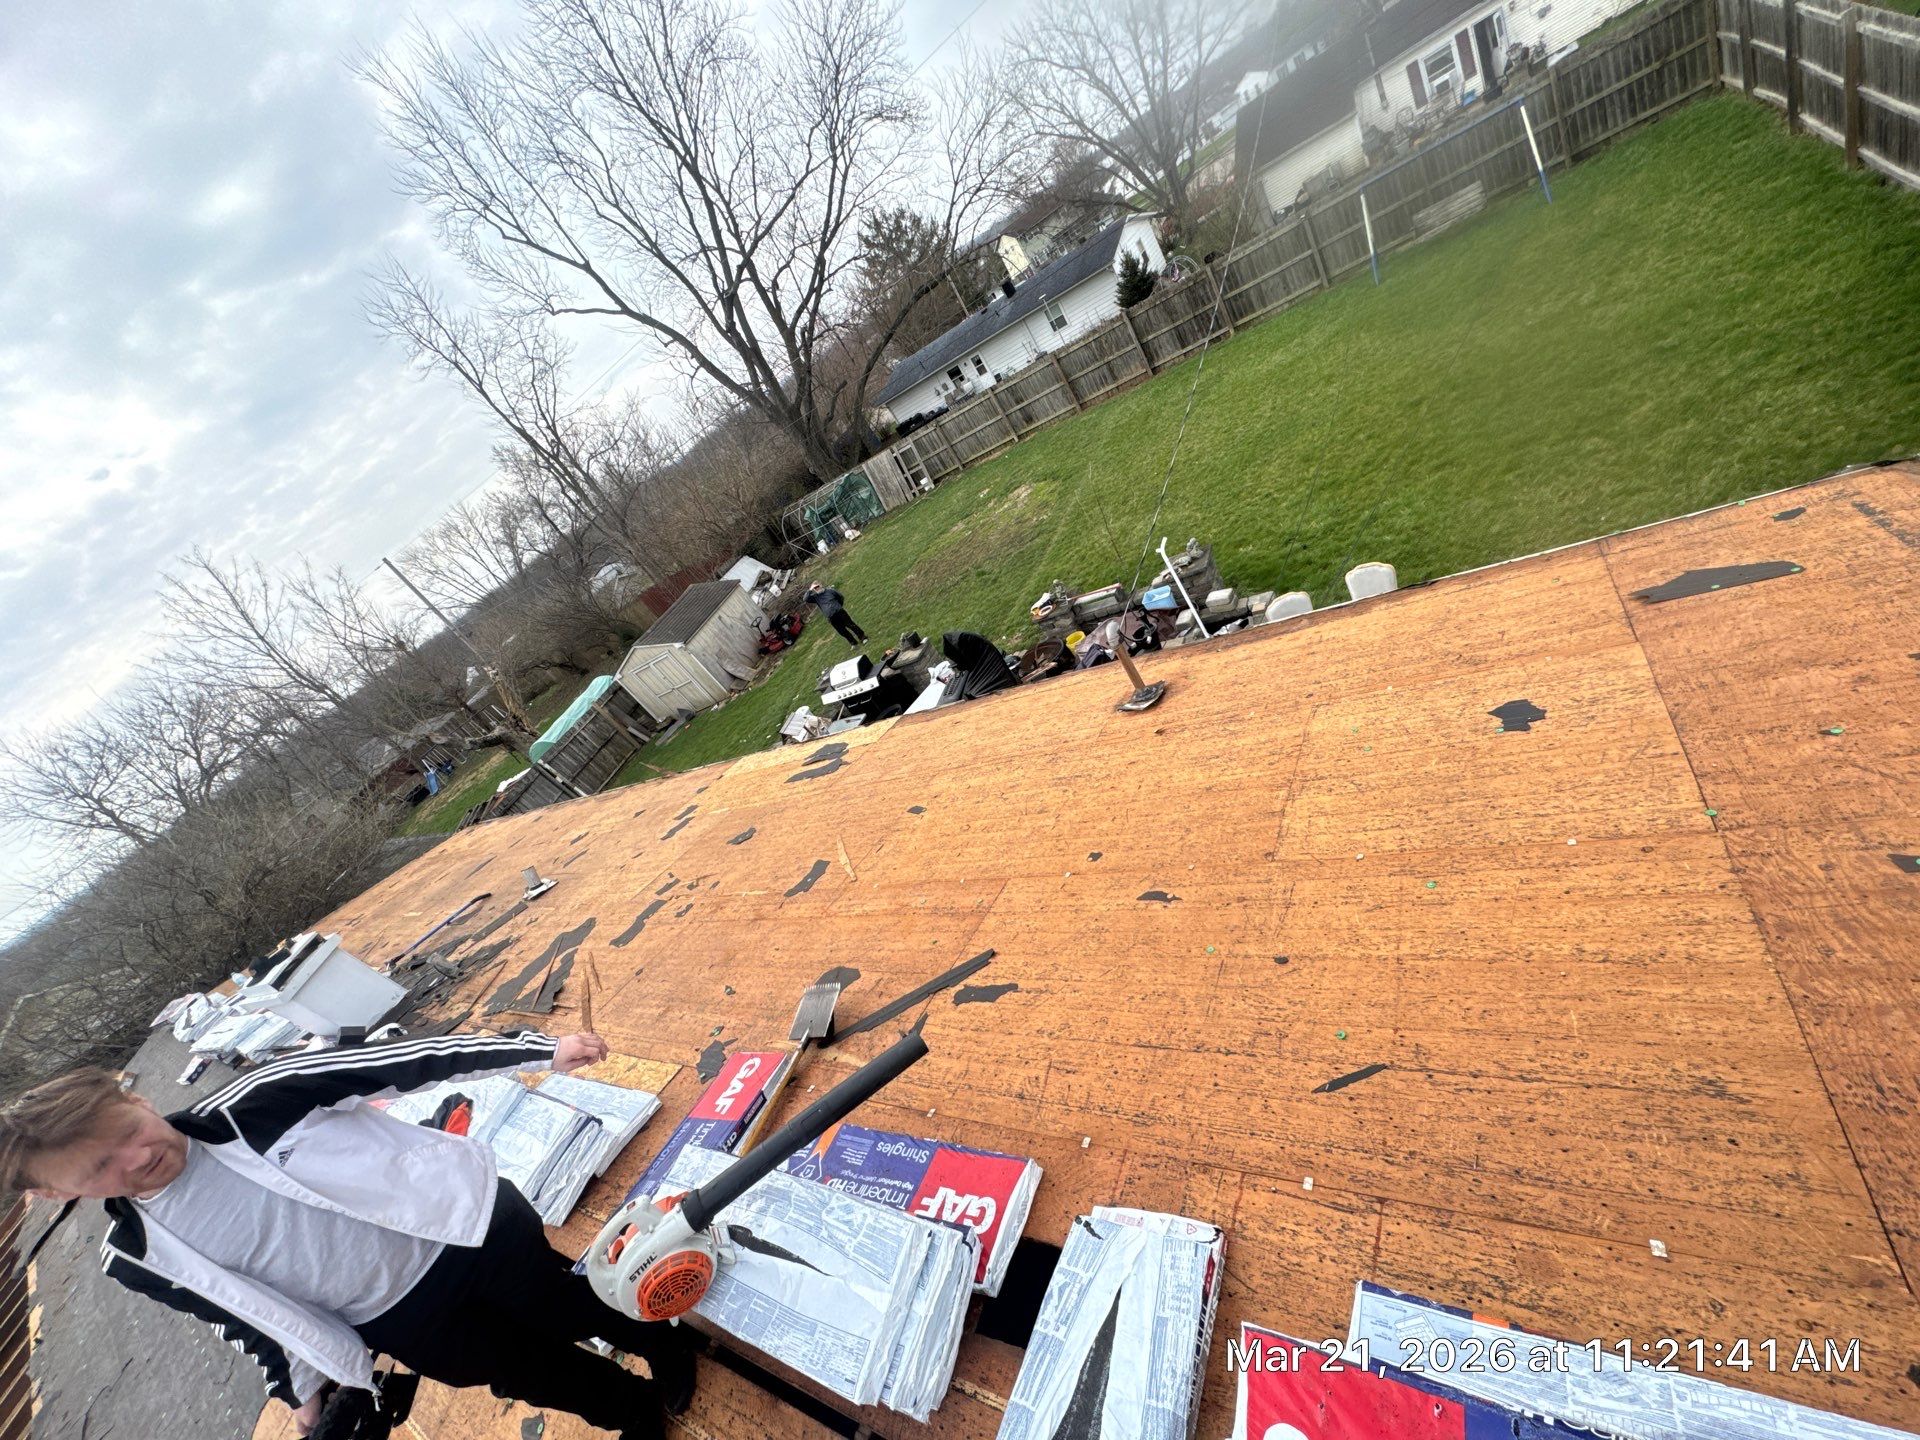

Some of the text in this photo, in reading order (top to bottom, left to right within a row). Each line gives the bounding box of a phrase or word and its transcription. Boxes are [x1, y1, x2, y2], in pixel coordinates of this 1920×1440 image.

[714, 1057, 761, 1115] GAF
[876, 1141, 930, 1164] Shingles
[915, 1186, 997, 1235] GAF
[629, 1255, 658, 1283] STIHL
